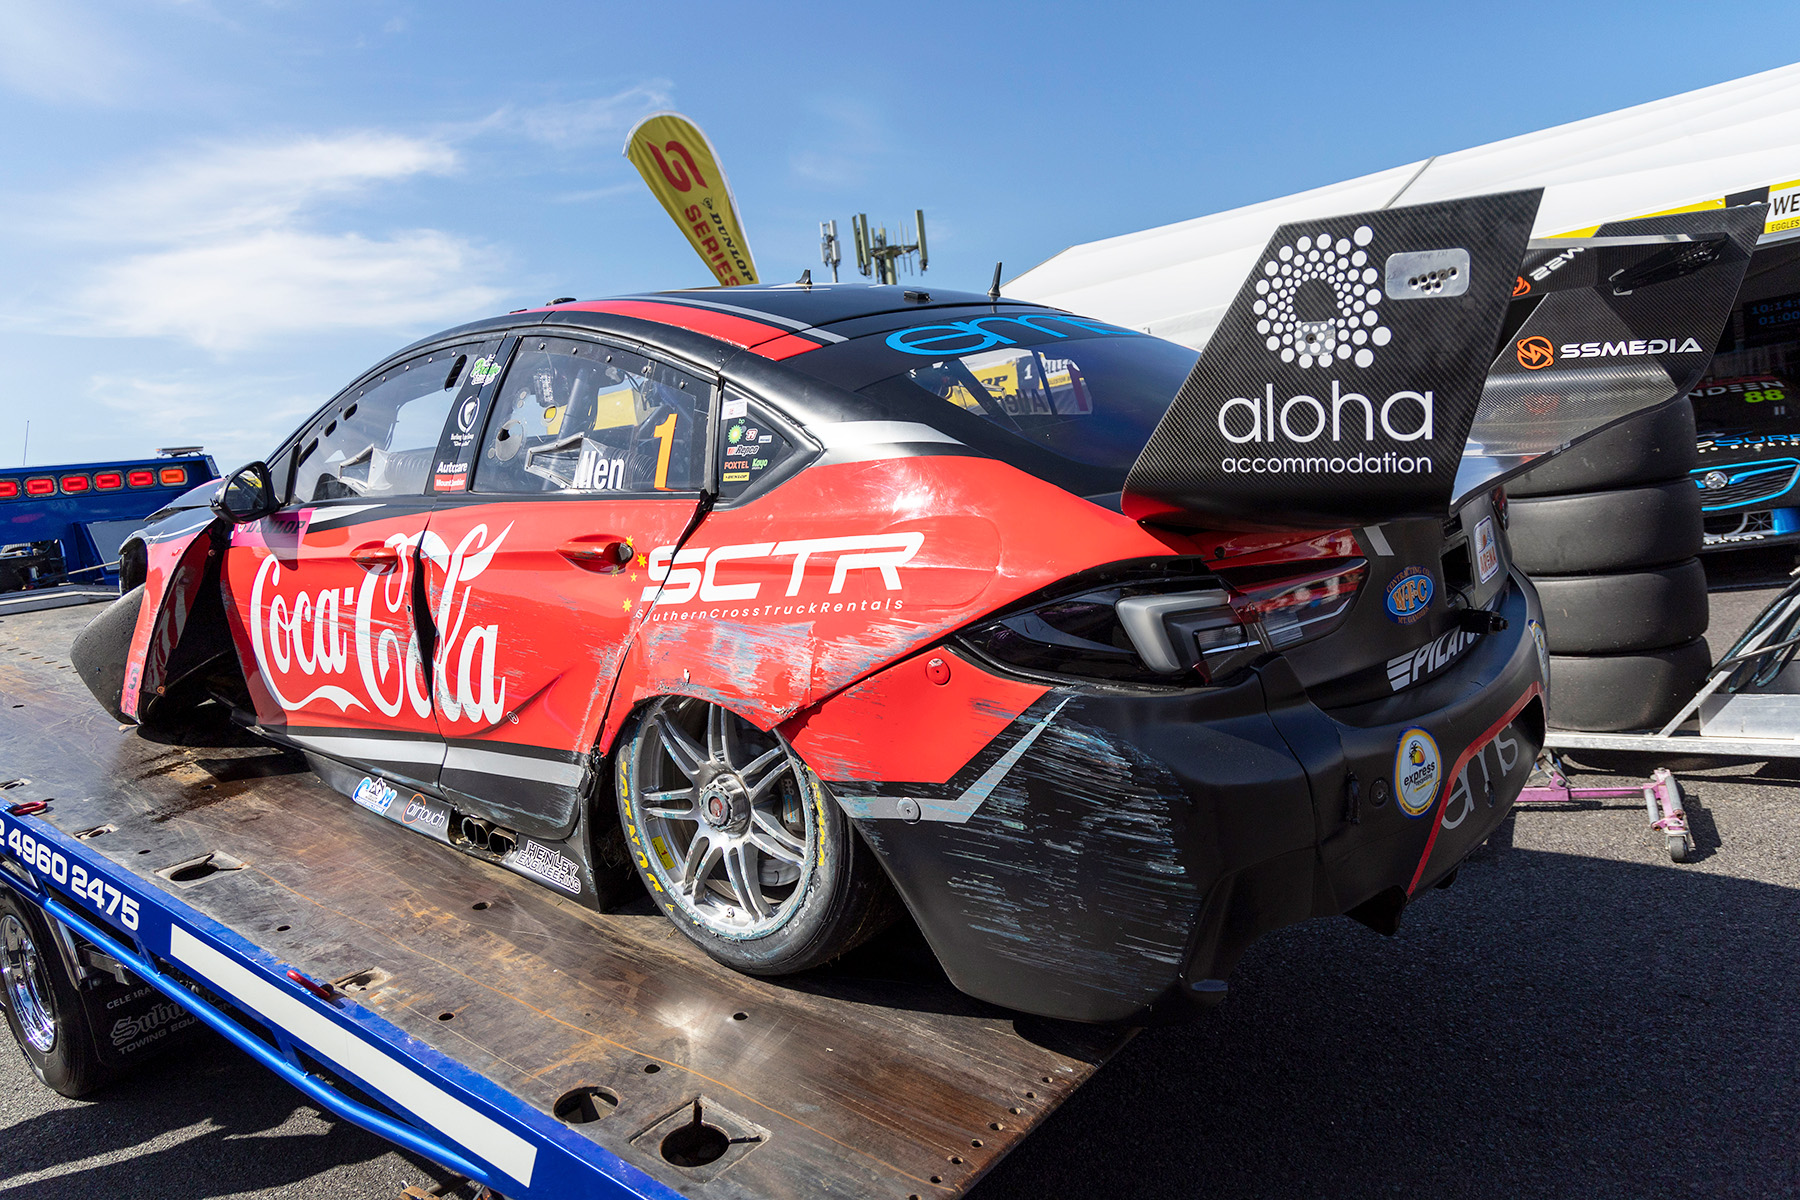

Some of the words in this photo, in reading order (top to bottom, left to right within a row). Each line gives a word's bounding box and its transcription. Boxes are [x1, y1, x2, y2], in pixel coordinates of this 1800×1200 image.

[710, 213, 754, 281] DUNLOP
[1560, 337, 1703, 359] SSMEDIA
[1744, 389, 1785, 403] 88
[1218, 380, 1434, 444] aloha
[653, 413, 678, 489] 1
[1222, 452, 1433, 474] accommodation
[724, 461, 750, 470] FOXTEL
[246, 520, 307, 534] DUNLOP
[640, 531, 925, 605] SCTR
[1404, 761, 1436, 786] express
[406, 803, 446, 828] airtouch
[516, 851, 580, 892] ENGINEERING
[527, 841, 579, 877] HENLEY
[8, 828, 67, 885] 4960
[72, 864, 140, 931] 2475
[119, 1029, 167, 1055] TOWING
